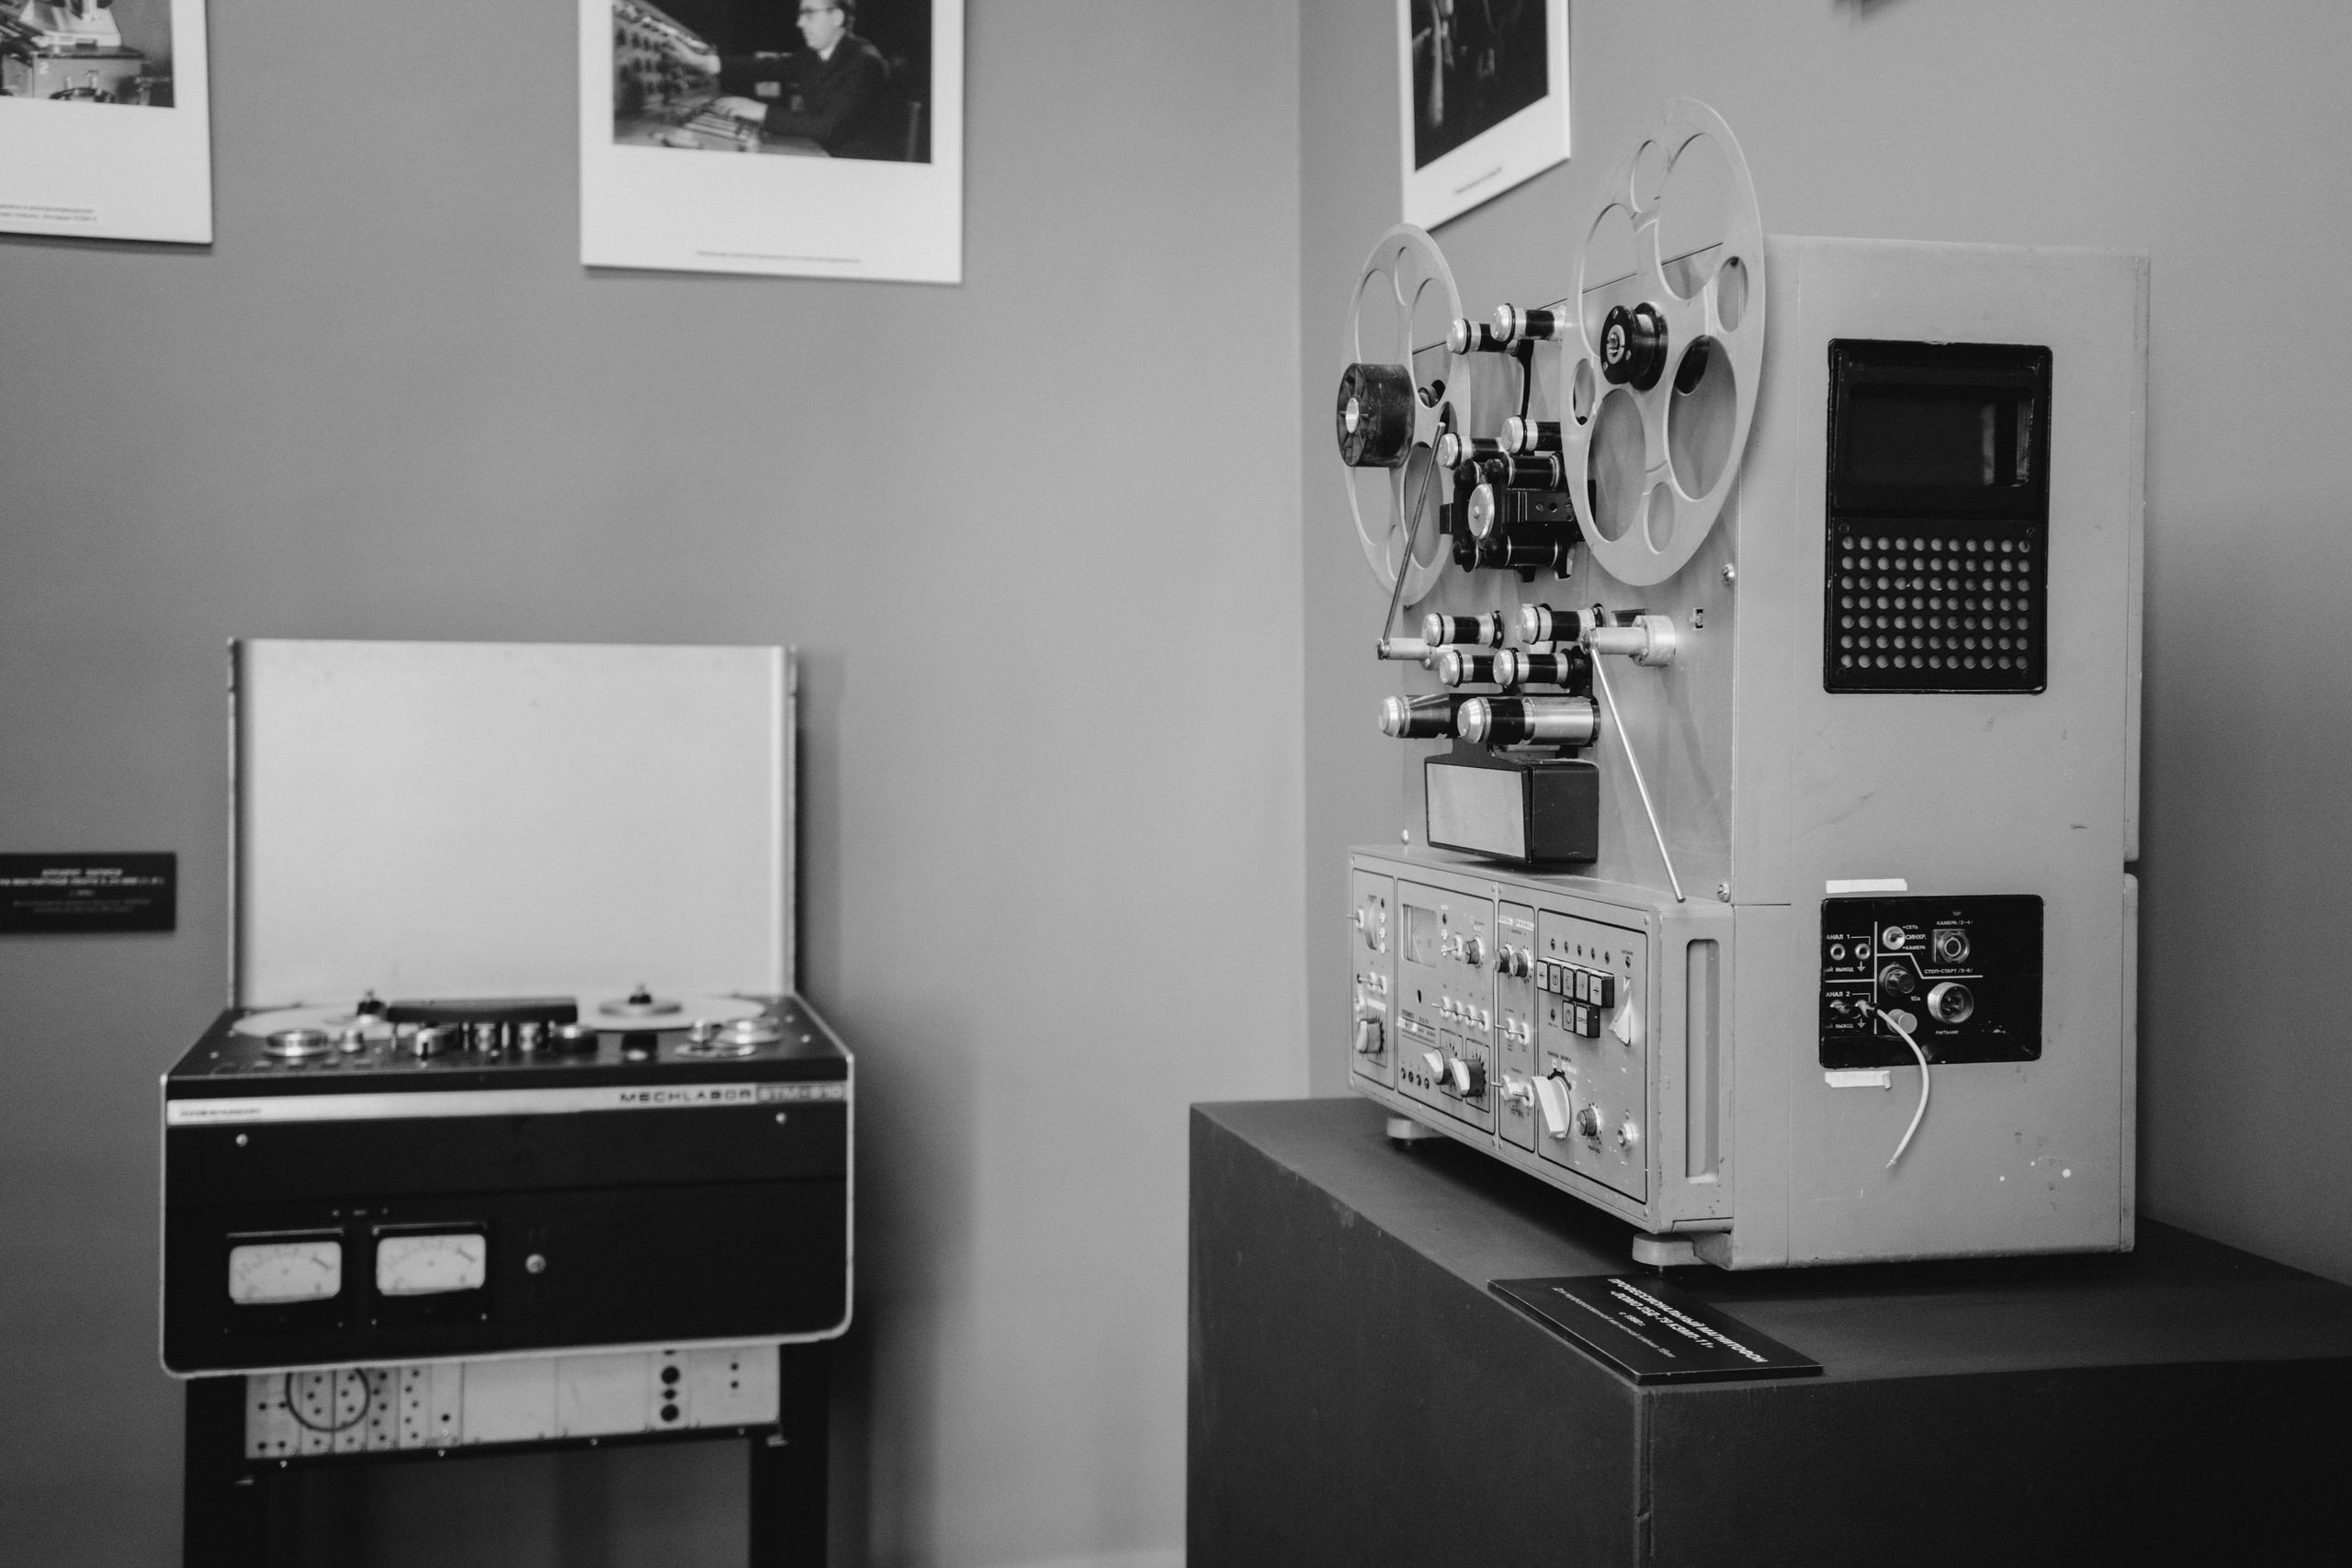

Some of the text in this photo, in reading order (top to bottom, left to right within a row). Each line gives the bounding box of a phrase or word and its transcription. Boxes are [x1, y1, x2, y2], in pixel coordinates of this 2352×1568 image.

[621, 1089, 752, 1101] MECHLABOR
[1608, 1279, 1769, 1362] ПРОФЕССИОНАЛЬНЫЙ МАГНИТОФОН
